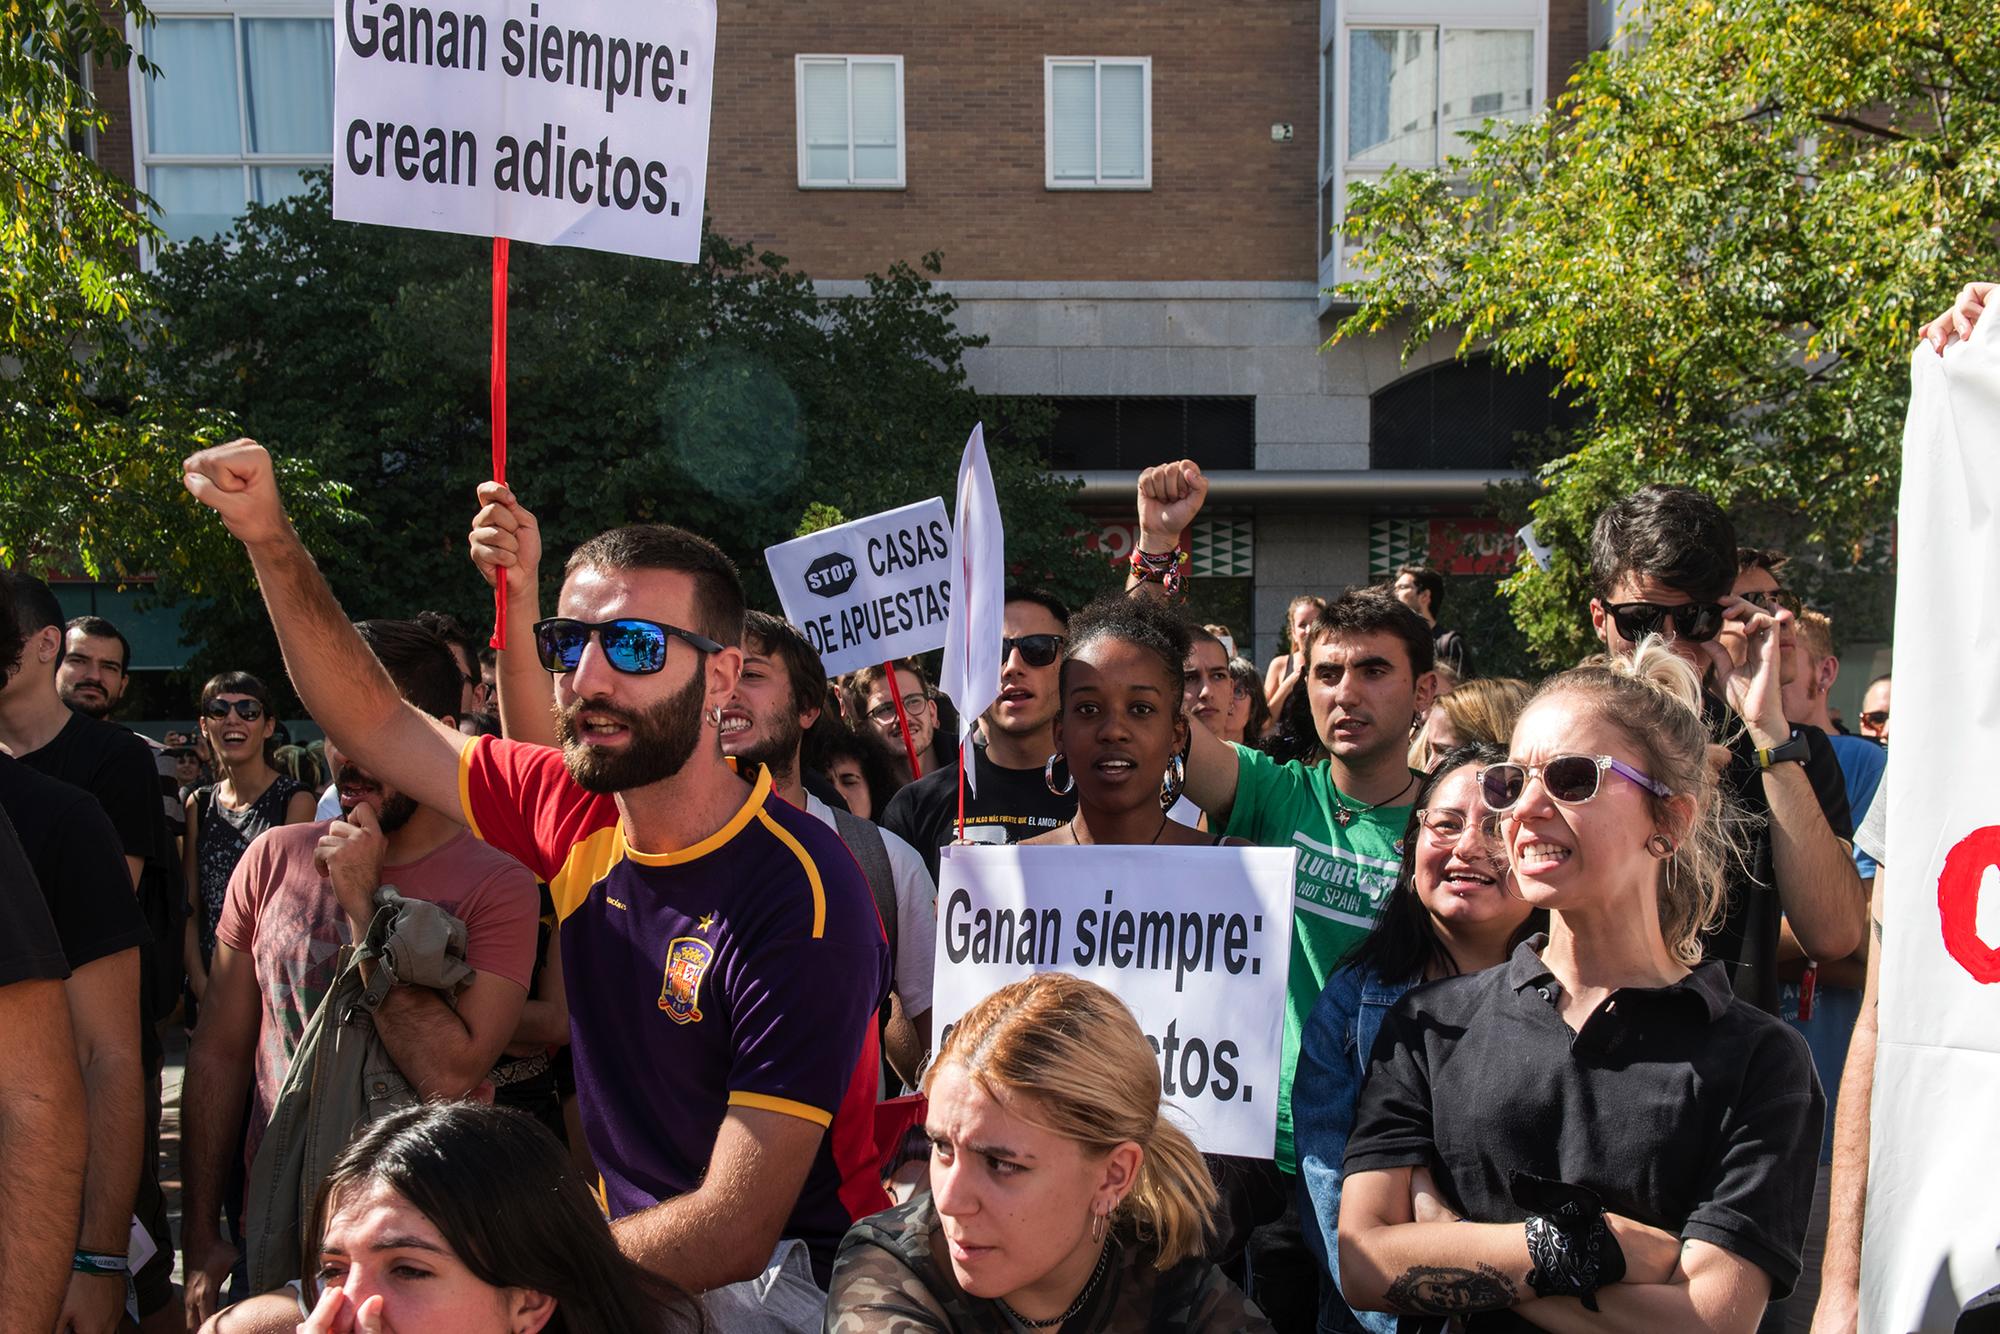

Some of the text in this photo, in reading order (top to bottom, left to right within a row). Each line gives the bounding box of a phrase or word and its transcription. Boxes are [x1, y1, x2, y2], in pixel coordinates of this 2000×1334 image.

[345, 0, 689, 113] Ganan siempre:
[346, 119, 680, 217] crean adictos.
[807, 560, 854, 590] STOP
[867, 520, 948, 577] CASAS
[804, 579, 952, 656] DE APUESTAS
[1000, 815, 1017, 824] FUERTE
[1028, 816, 1036, 826] EL
[1037, 817, 1057, 828] AMOR
[1297, 881, 1362, 913] NOT SPAIN
[944, 888, 1262, 993] Ganan siempre:
[1146, 1018, 1253, 1103] tos.
